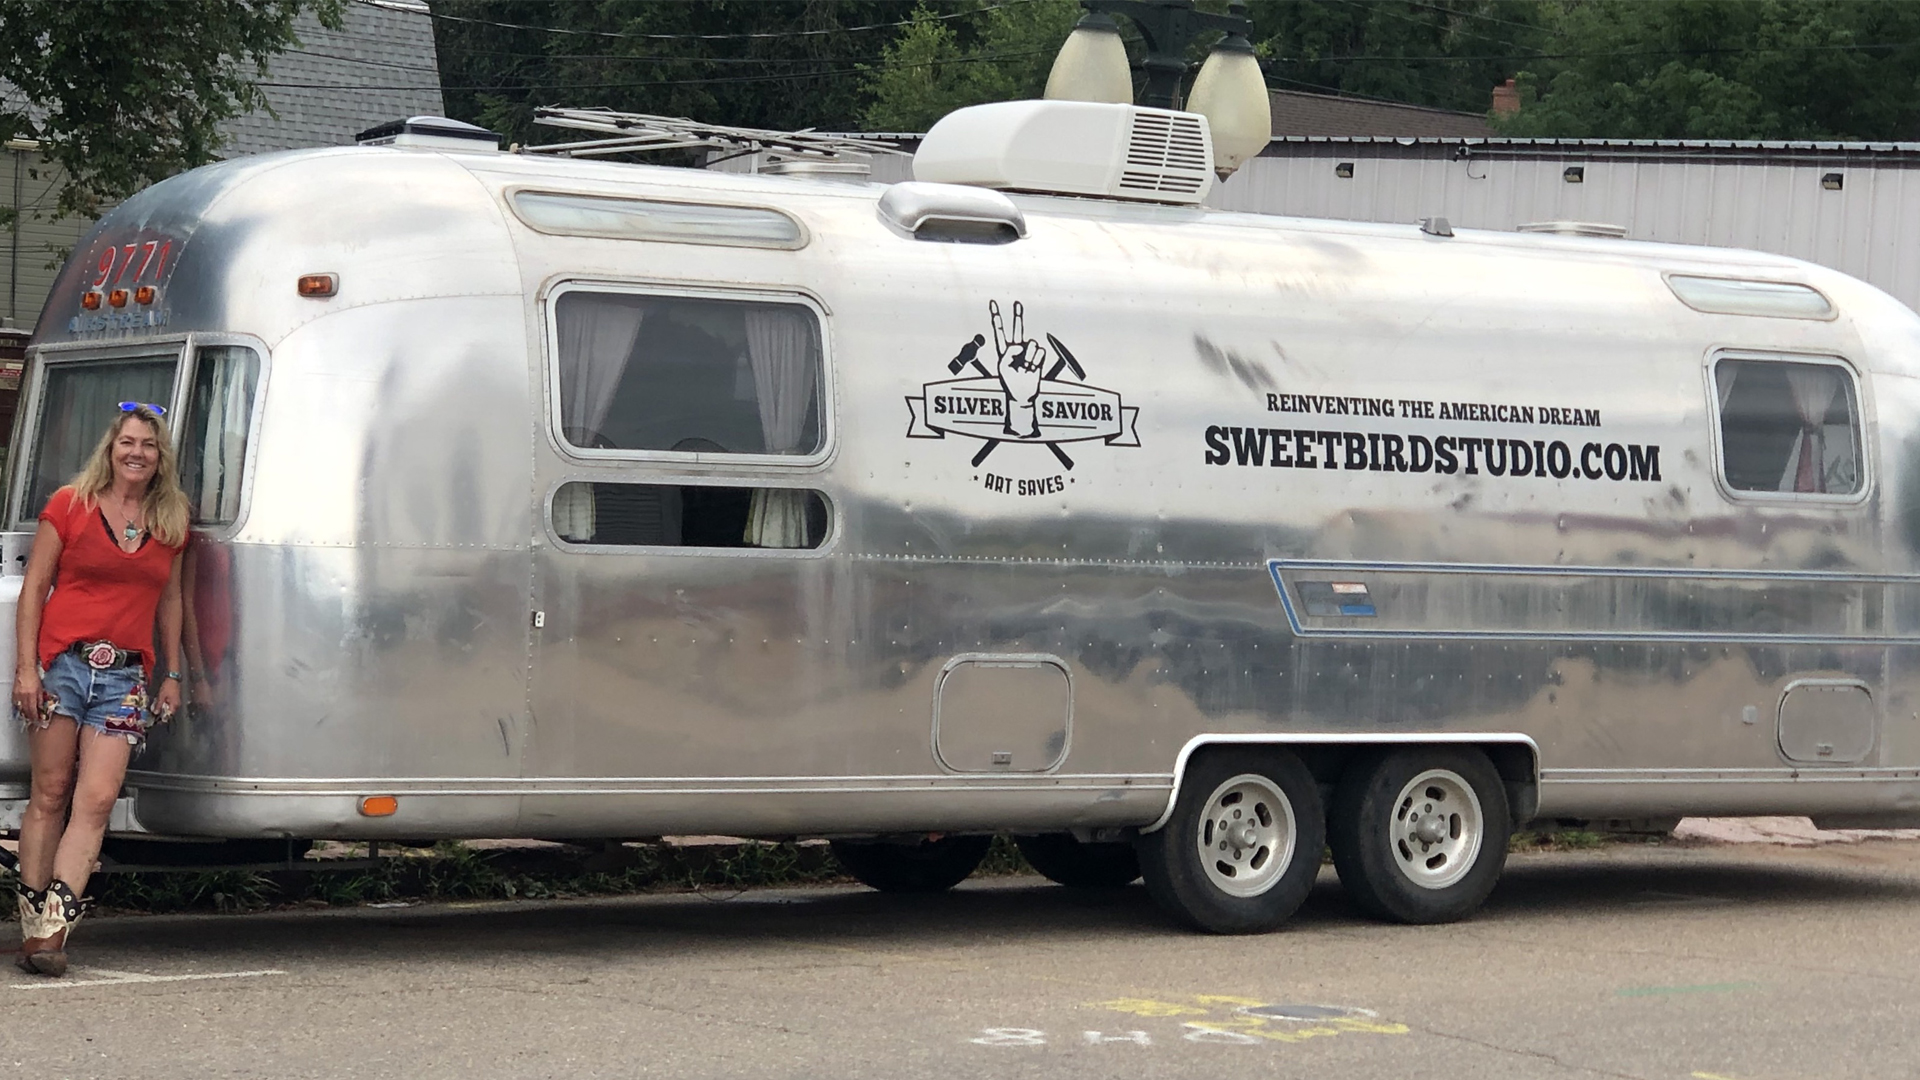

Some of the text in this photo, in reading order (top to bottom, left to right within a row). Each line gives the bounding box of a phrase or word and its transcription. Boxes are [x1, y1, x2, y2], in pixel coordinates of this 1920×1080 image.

[92, 239, 172, 291] 9771
[68, 308, 171, 333] AIRSTREAM
[934, 395, 1113, 421] SILVER SAVIOR
[1266, 393, 1601, 427] REINVENTING THE AMERICAN DREAM
[1205, 425, 1662, 481] SWEETBIRDSTUDIO.COM
[984, 473, 1065, 496] ART SAVES
